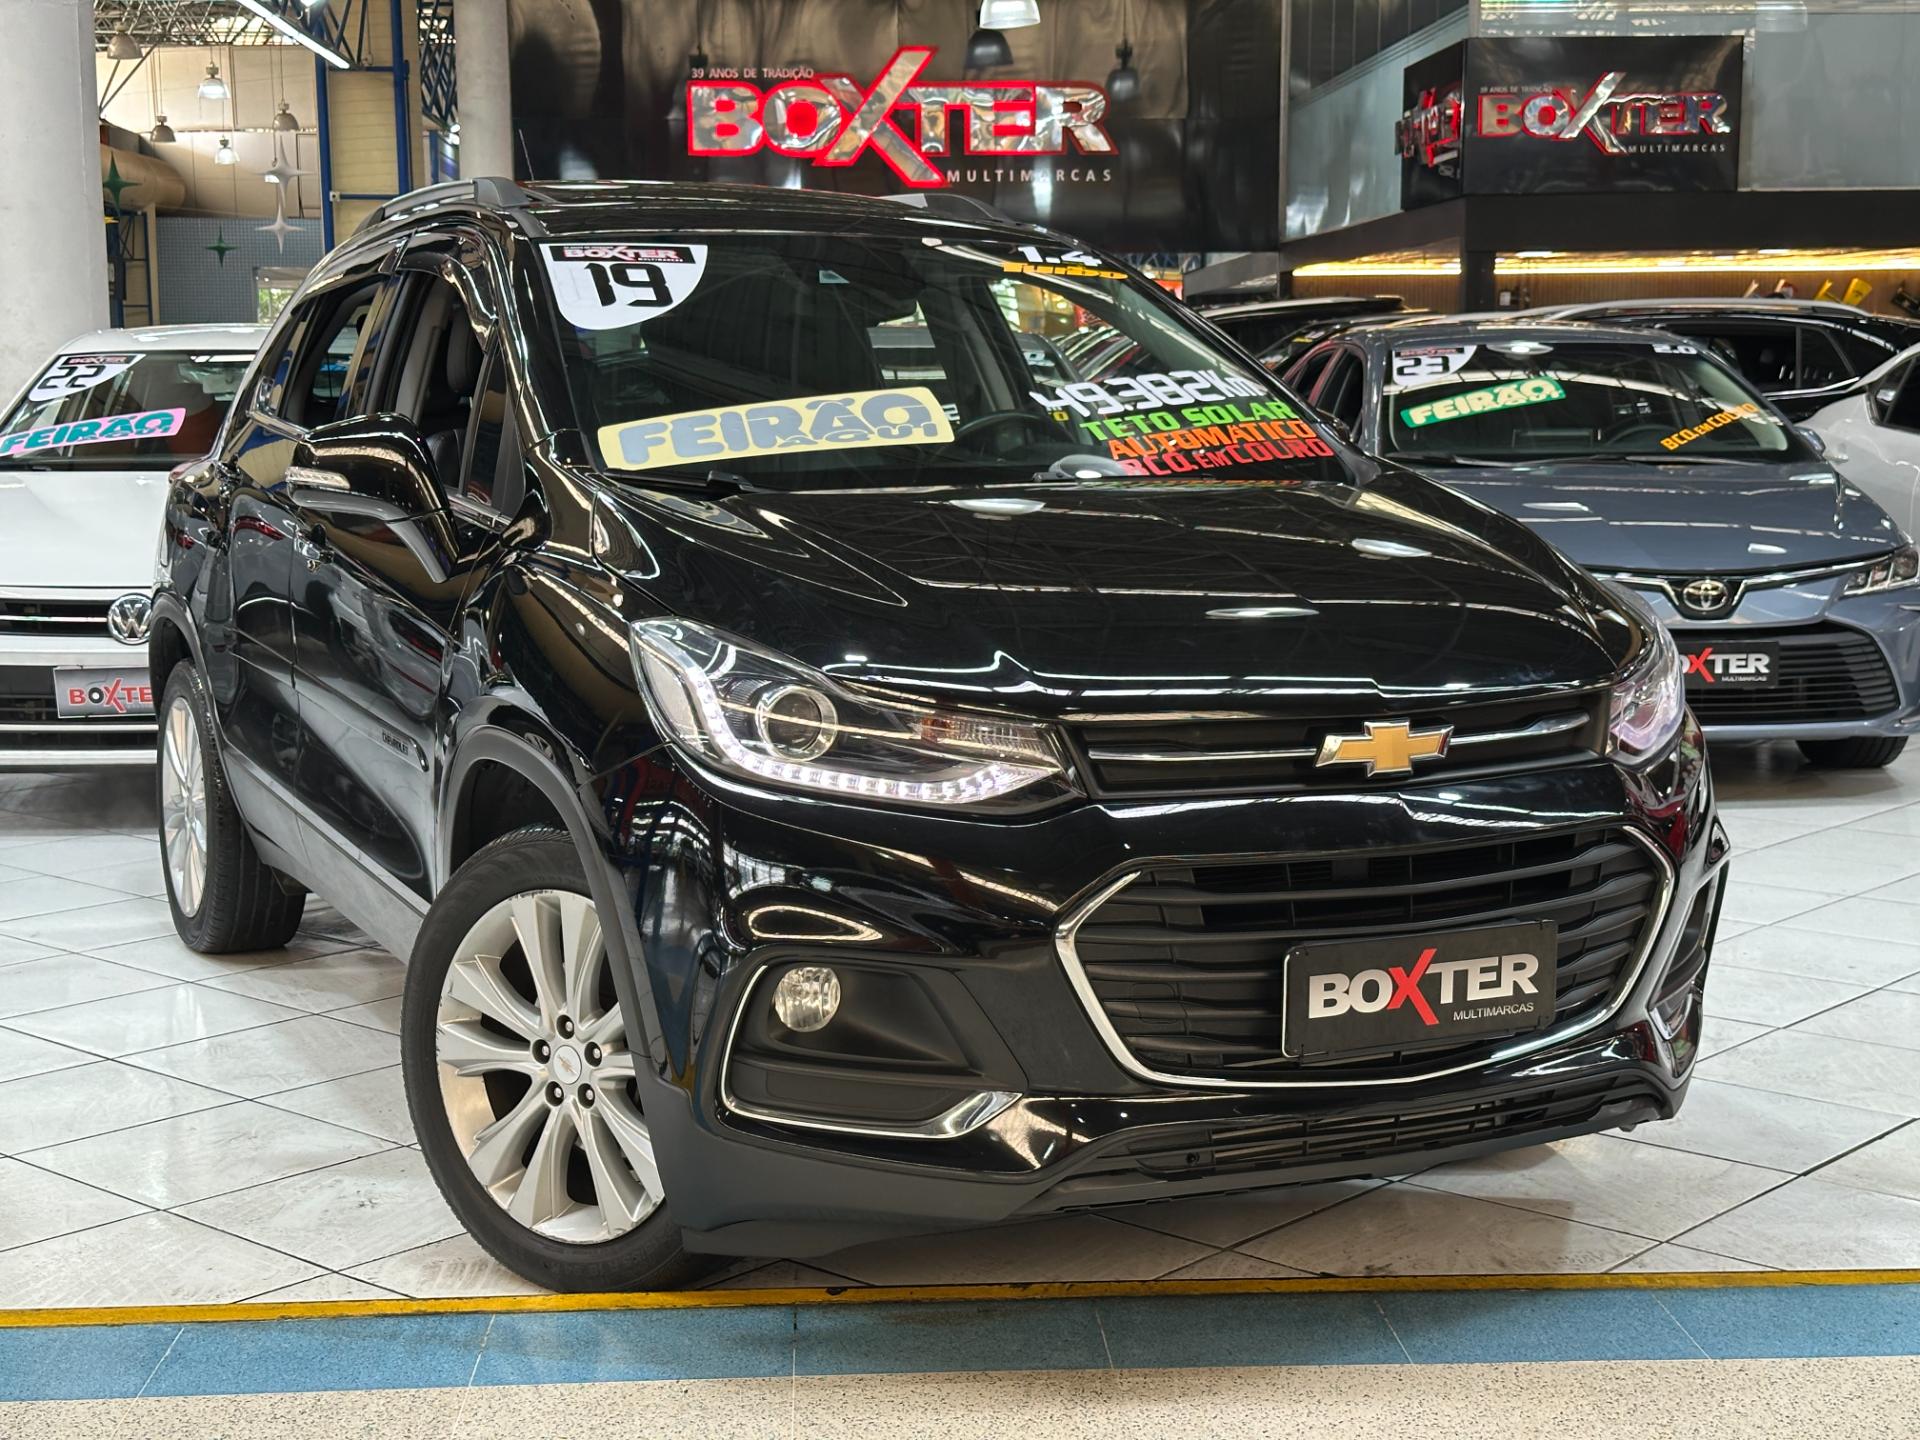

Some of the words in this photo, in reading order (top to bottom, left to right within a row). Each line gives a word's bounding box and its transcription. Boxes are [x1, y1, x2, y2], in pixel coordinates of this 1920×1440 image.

[690, 67, 705, 79] 39
[708, 67, 739, 79] ANOS
[743, 67, 757, 79] DE
[762, 65, 815, 80] TRADIÇÃO
[687, 46, 1118, 188] BOXTER
[1478, 71, 1732, 156] BOXTER
[1628, 143, 1726, 154] MULTIMARCAS
[947, 168, 1112, 183] MULTIMARCAS
[563, 246, 680, 263] BOXTER
[1018, 246, 1102, 267] 1.4
[584, 262, 674, 307] 19
[1080, 411, 1181, 441] TETO
[1181, 401, 1300, 427] SOLAR
[1409, 380, 1557, 425] FEIRÃO
[0, 411, 175, 451] FEIRÃO
[619, 393, 932, 465] FEIRÃO
[1225, 438, 1335, 464] COURO
[1308, 948, 1540, 1026] BOXTER
[1453, 1002, 1535, 1021] MULTIMARCAS
